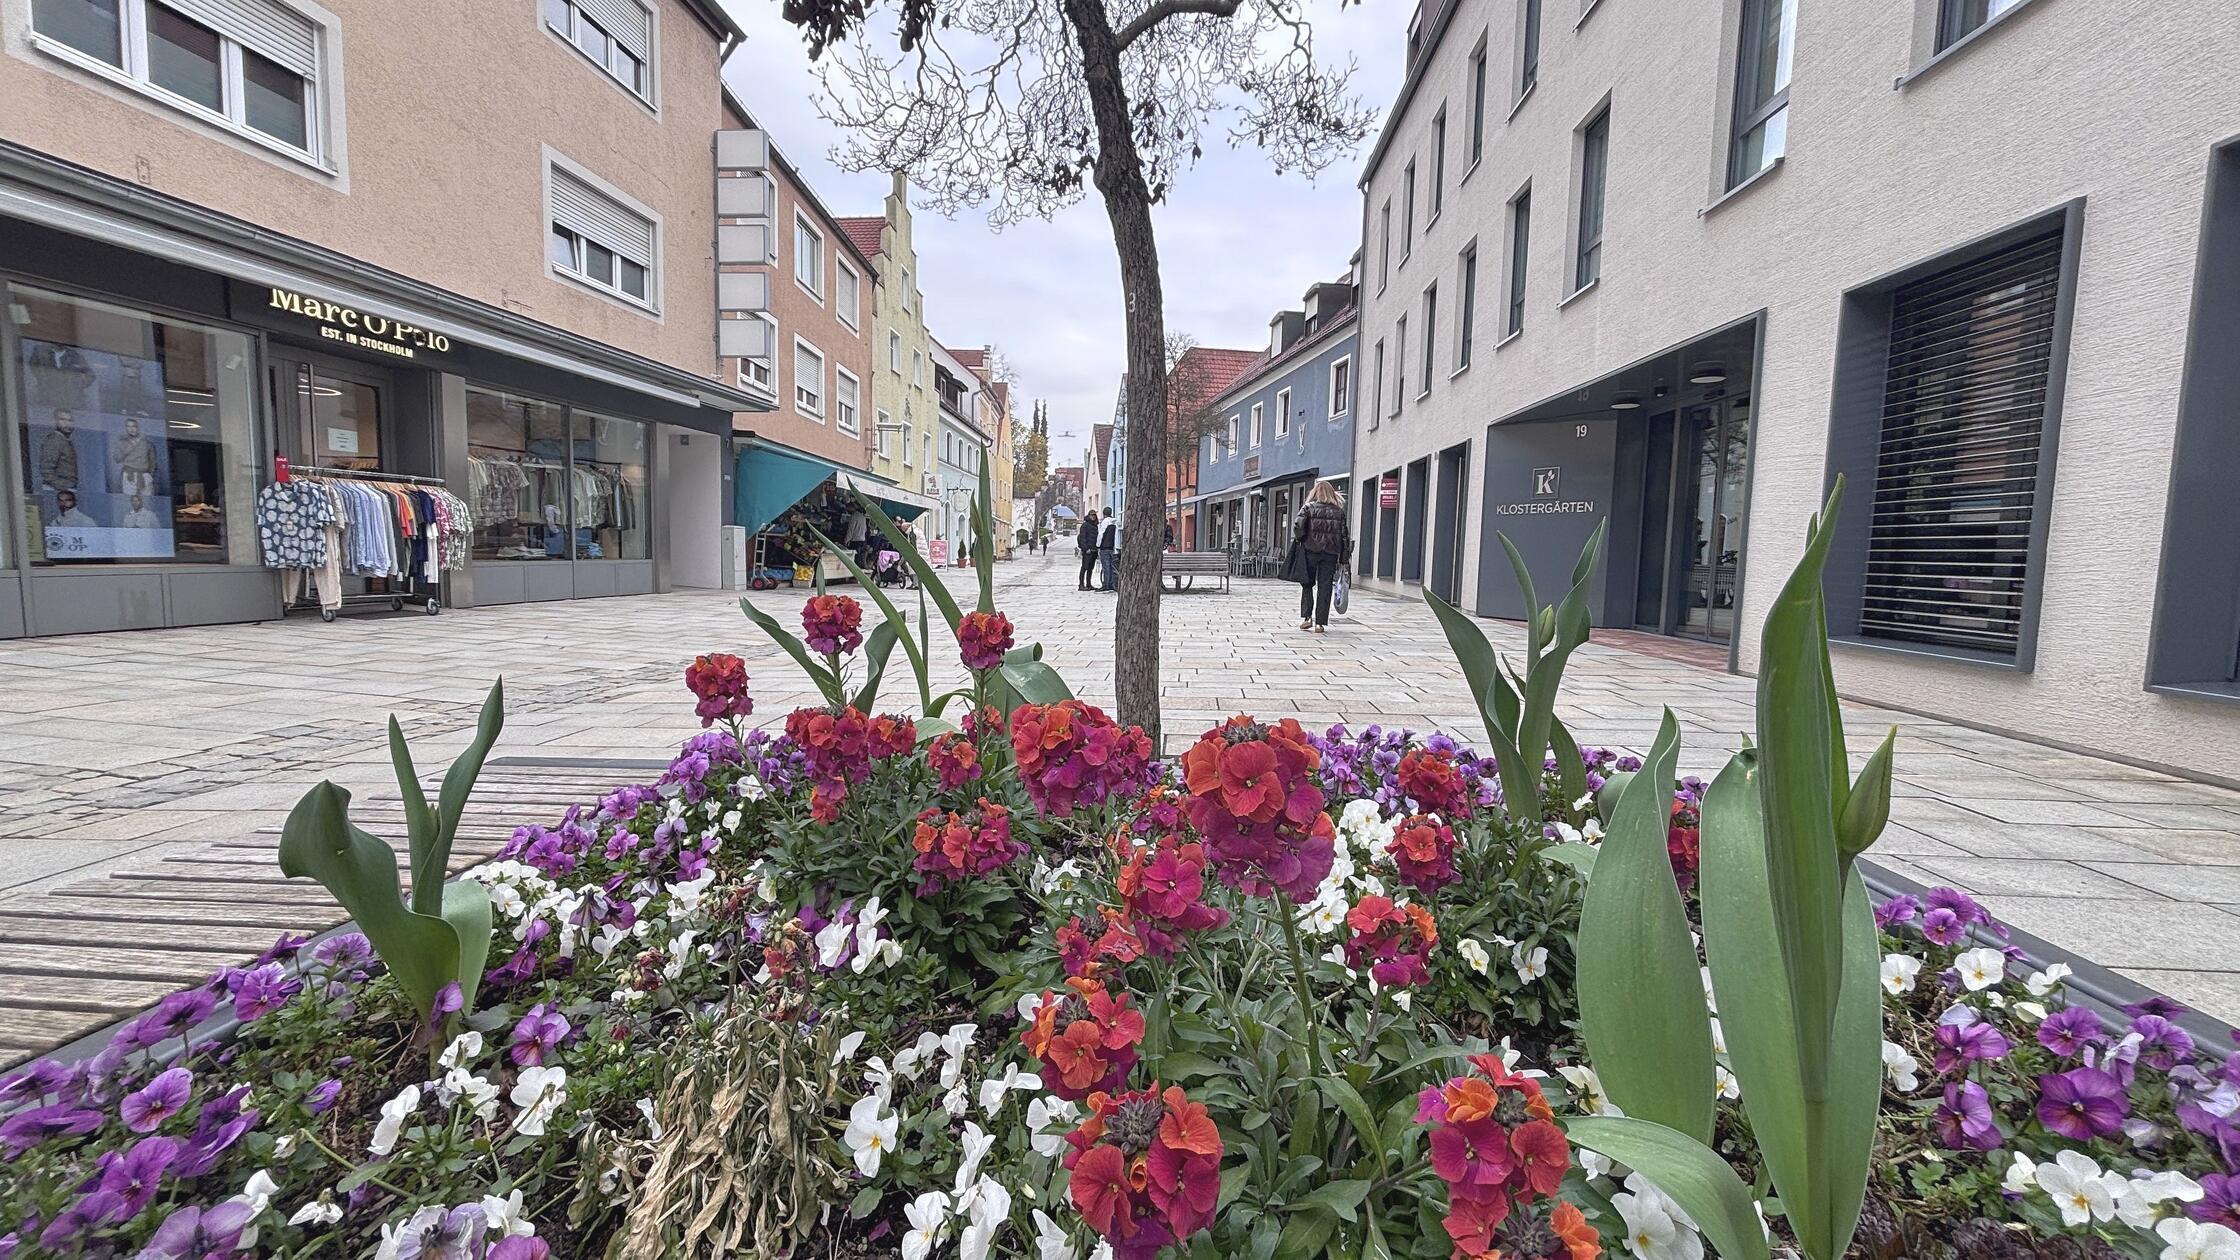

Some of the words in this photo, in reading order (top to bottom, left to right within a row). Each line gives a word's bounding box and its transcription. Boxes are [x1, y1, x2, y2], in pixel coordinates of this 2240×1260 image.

[269, 288, 358, 328] Marc
[363, 314, 450, 352] OPolo
[321, 326, 344, 342] EST.
[346, 332, 357, 346] IN
[359, 336, 414, 359] STOCKHOLM
[1575, 424, 1588, 438] 19
[1496, 501, 1594, 515] KLOSTERGÄRTEN
